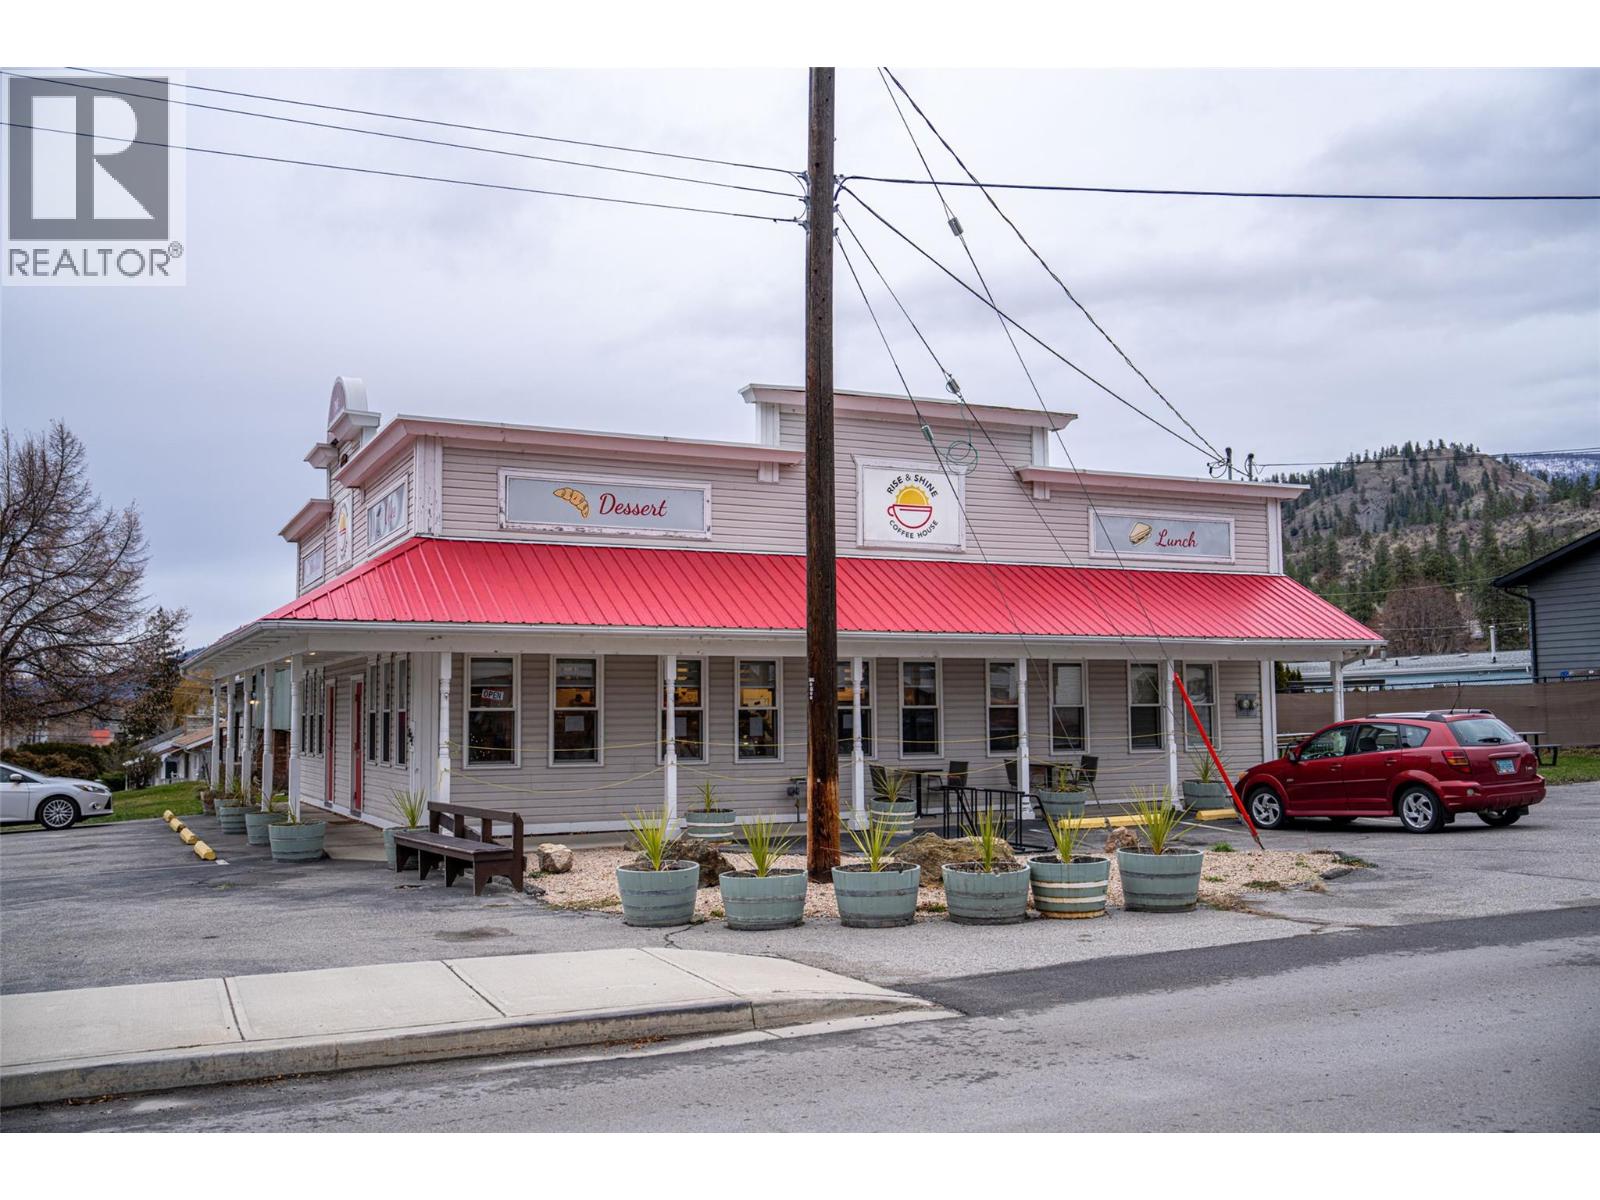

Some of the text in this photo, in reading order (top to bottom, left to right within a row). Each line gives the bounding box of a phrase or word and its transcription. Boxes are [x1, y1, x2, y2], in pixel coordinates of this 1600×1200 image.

[887, 474, 938, 498] RISE & SHINE
[599, 493, 667, 517] Dessert
[889, 520, 938, 539] COFFEE HOUSE
[1155, 528, 1198, 548] Lunch
[482, 690, 502, 699] OPEN
